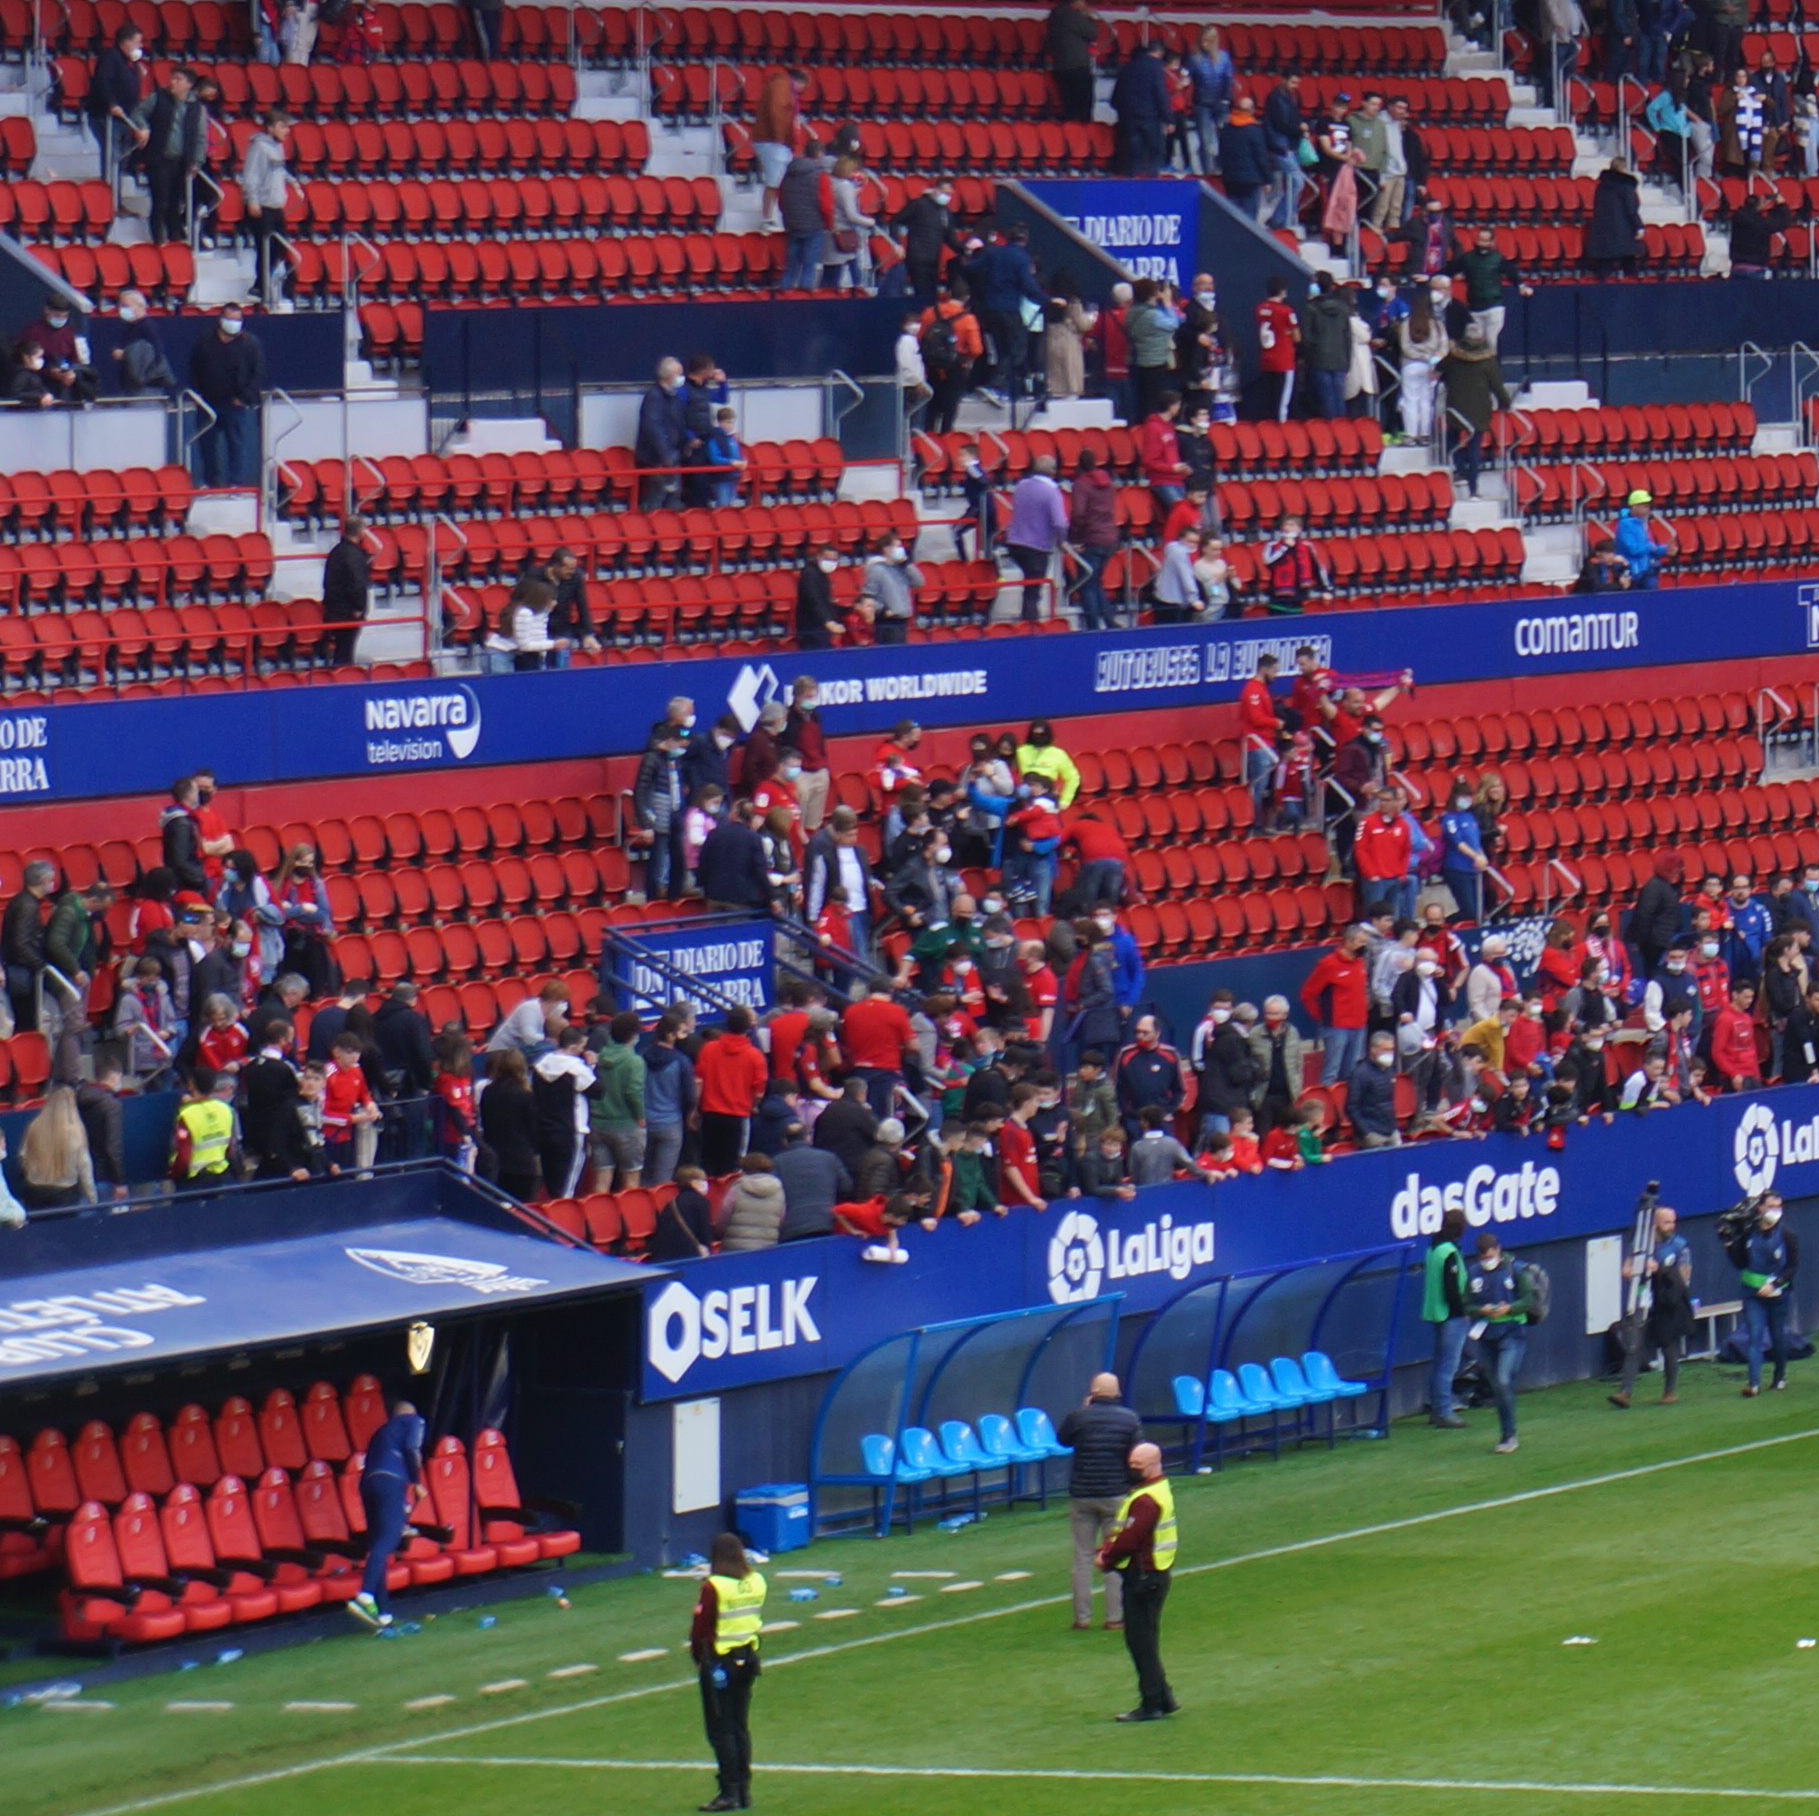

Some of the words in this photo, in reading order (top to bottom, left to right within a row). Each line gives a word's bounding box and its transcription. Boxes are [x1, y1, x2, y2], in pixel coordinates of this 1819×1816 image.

[1153, 215, 1182, 246] DE
[1260, 321, 1276, 349] 6
[865, 670, 988, 705] WORLDWIDE
[1094, 644, 1201, 694] AUTOBUSES
[365, 693, 468, 732] Navarra
[16, 717, 49, 749] DE
[366, 737, 443, 764] television
[672, 942, 736, 978] DIARIO
[735, 938, 766, 971] DE
[1390, 1160, 1561, 1240] dasGate
[1106, 1212, 1216, 1281] LaLiga
